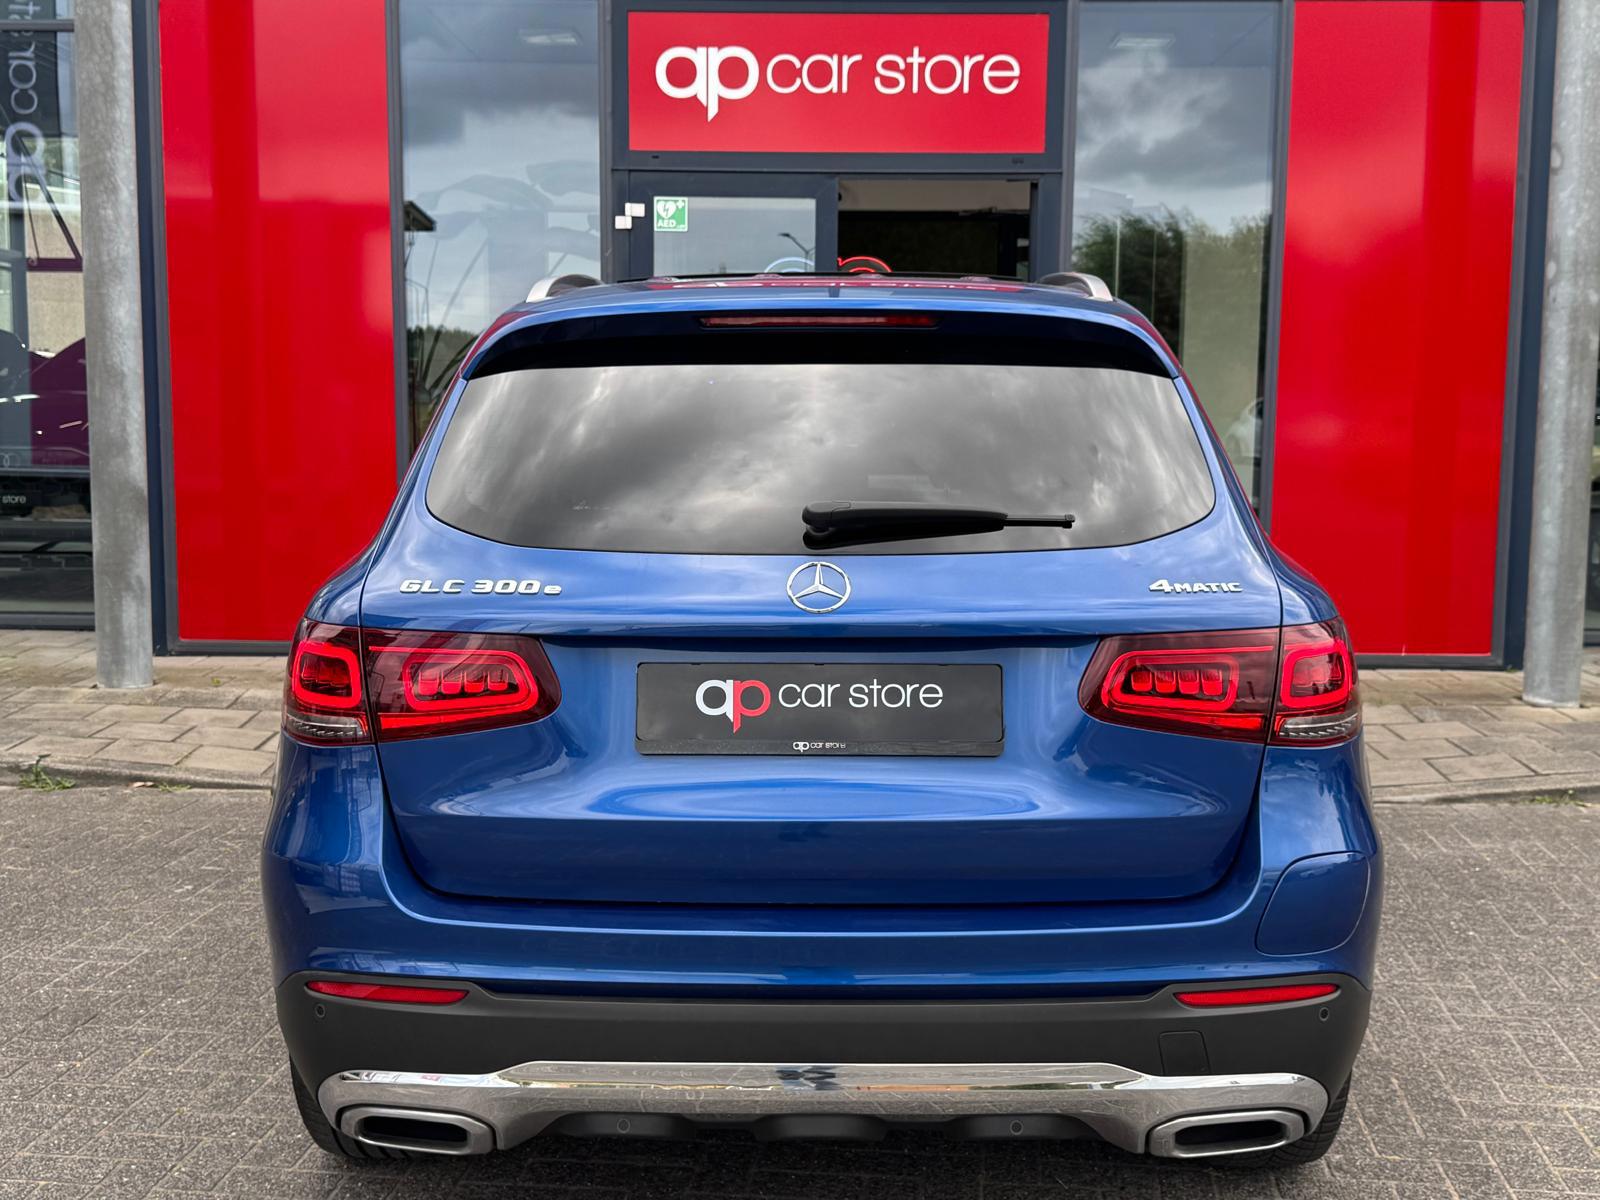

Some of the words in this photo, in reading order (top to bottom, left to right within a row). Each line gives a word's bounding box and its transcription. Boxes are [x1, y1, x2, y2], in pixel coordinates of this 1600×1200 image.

[766, 53, 862, 94] car
[874, 46, 1021, 95] store
[657, 219, 677, 228] AED
[2, 494, 27, 504] store
[399, 579, 465, 594] GLC
[1148, 579, 1244, 593] 4MATIC
[778, 683, 840, 708] car
[848, 678, 943, 708] store
[825, 741, 847, 749] store
